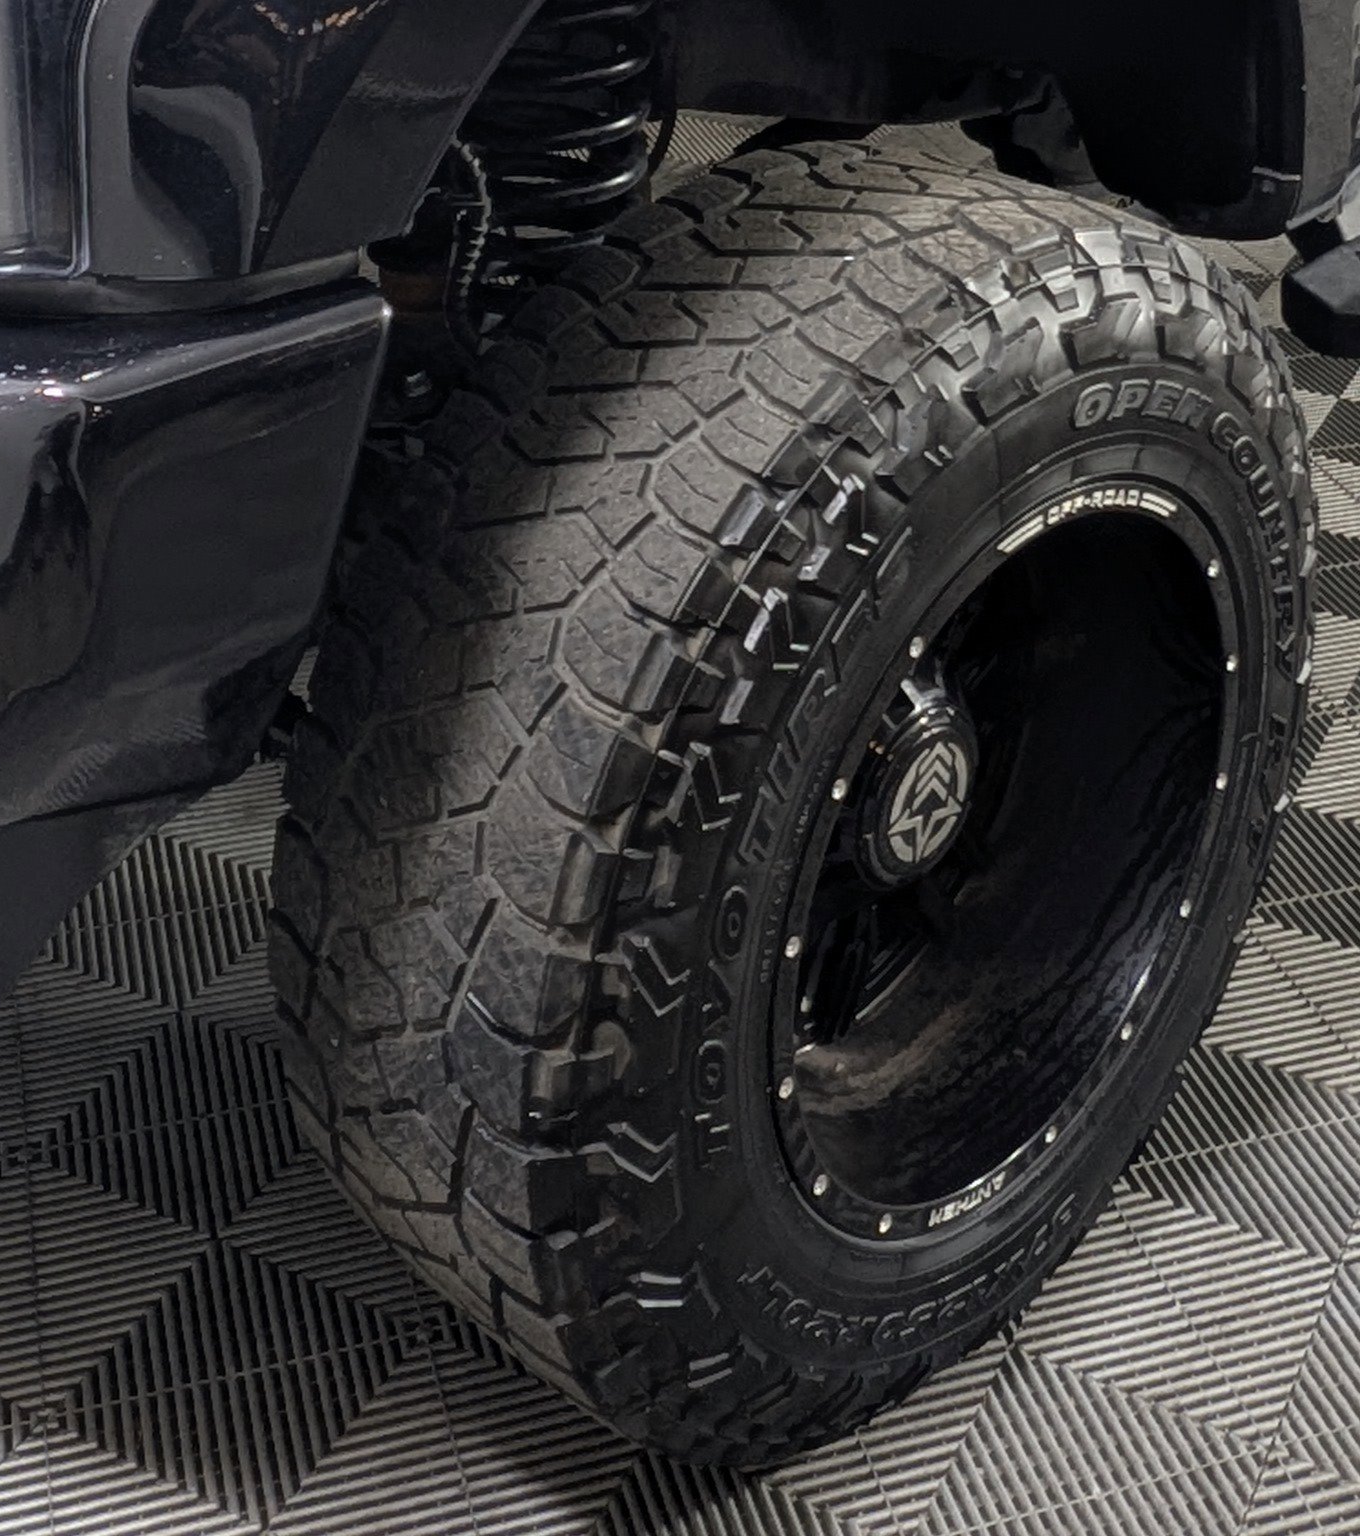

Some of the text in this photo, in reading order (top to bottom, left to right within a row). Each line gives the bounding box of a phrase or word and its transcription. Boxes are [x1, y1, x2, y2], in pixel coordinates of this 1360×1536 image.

[1046, 488, 1141, 525] OFF-ROAD
[1071, 378, 1214, 430] OPEN
[1208, 411, 1296, 684] COUNTRY
[927, 1170, 1007, 1228] ANTHEM
